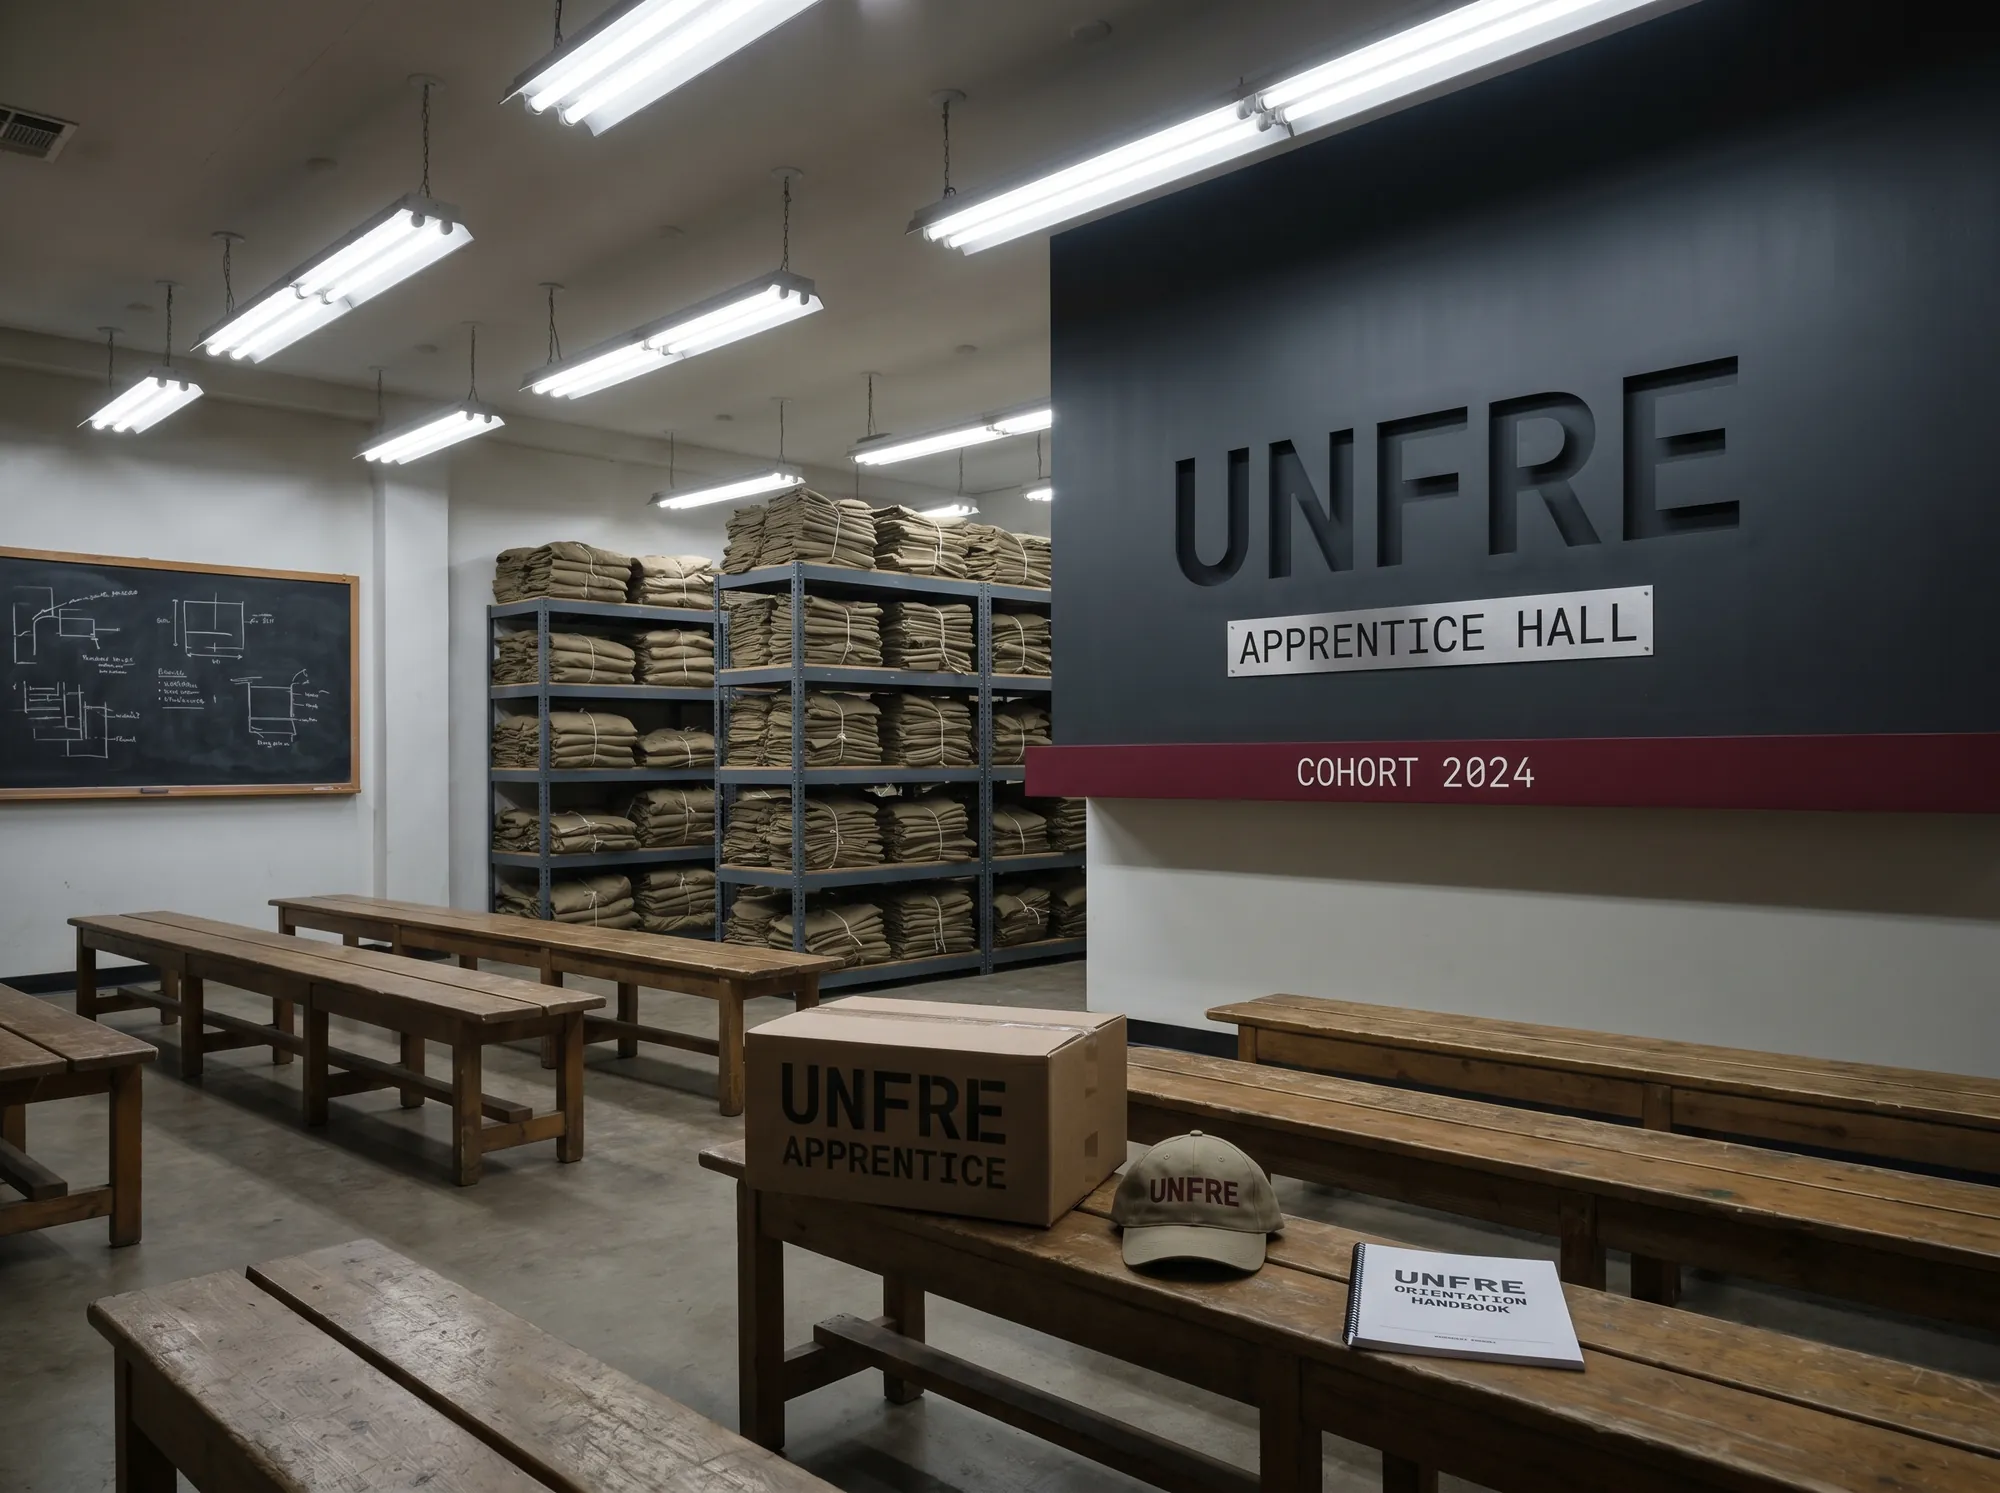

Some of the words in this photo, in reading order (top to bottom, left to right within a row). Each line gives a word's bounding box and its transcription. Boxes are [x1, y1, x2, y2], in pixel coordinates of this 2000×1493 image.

[1174, 355, 1740, 587] UNFRE
[1239, 613, 1485, 664] APPRENTICE
[1518, 603, 1637, 648] HALL
[1296, 756, 1419, 788] COHORT
[1442, 756, 1535, 789] 2024
[781, 1062, 1006, 1145] UNFRE
[782, 1135, 1006, 1190] APPRENTICE
[1149, 1177, 1240, 1207] UNFRE
[1394, 1269, 1526, 1295] UNFRE
[1394, 1285, 1527, 1306] ORIENTATION
[1411, 1296, 1510, 1314] HANDBOOK
